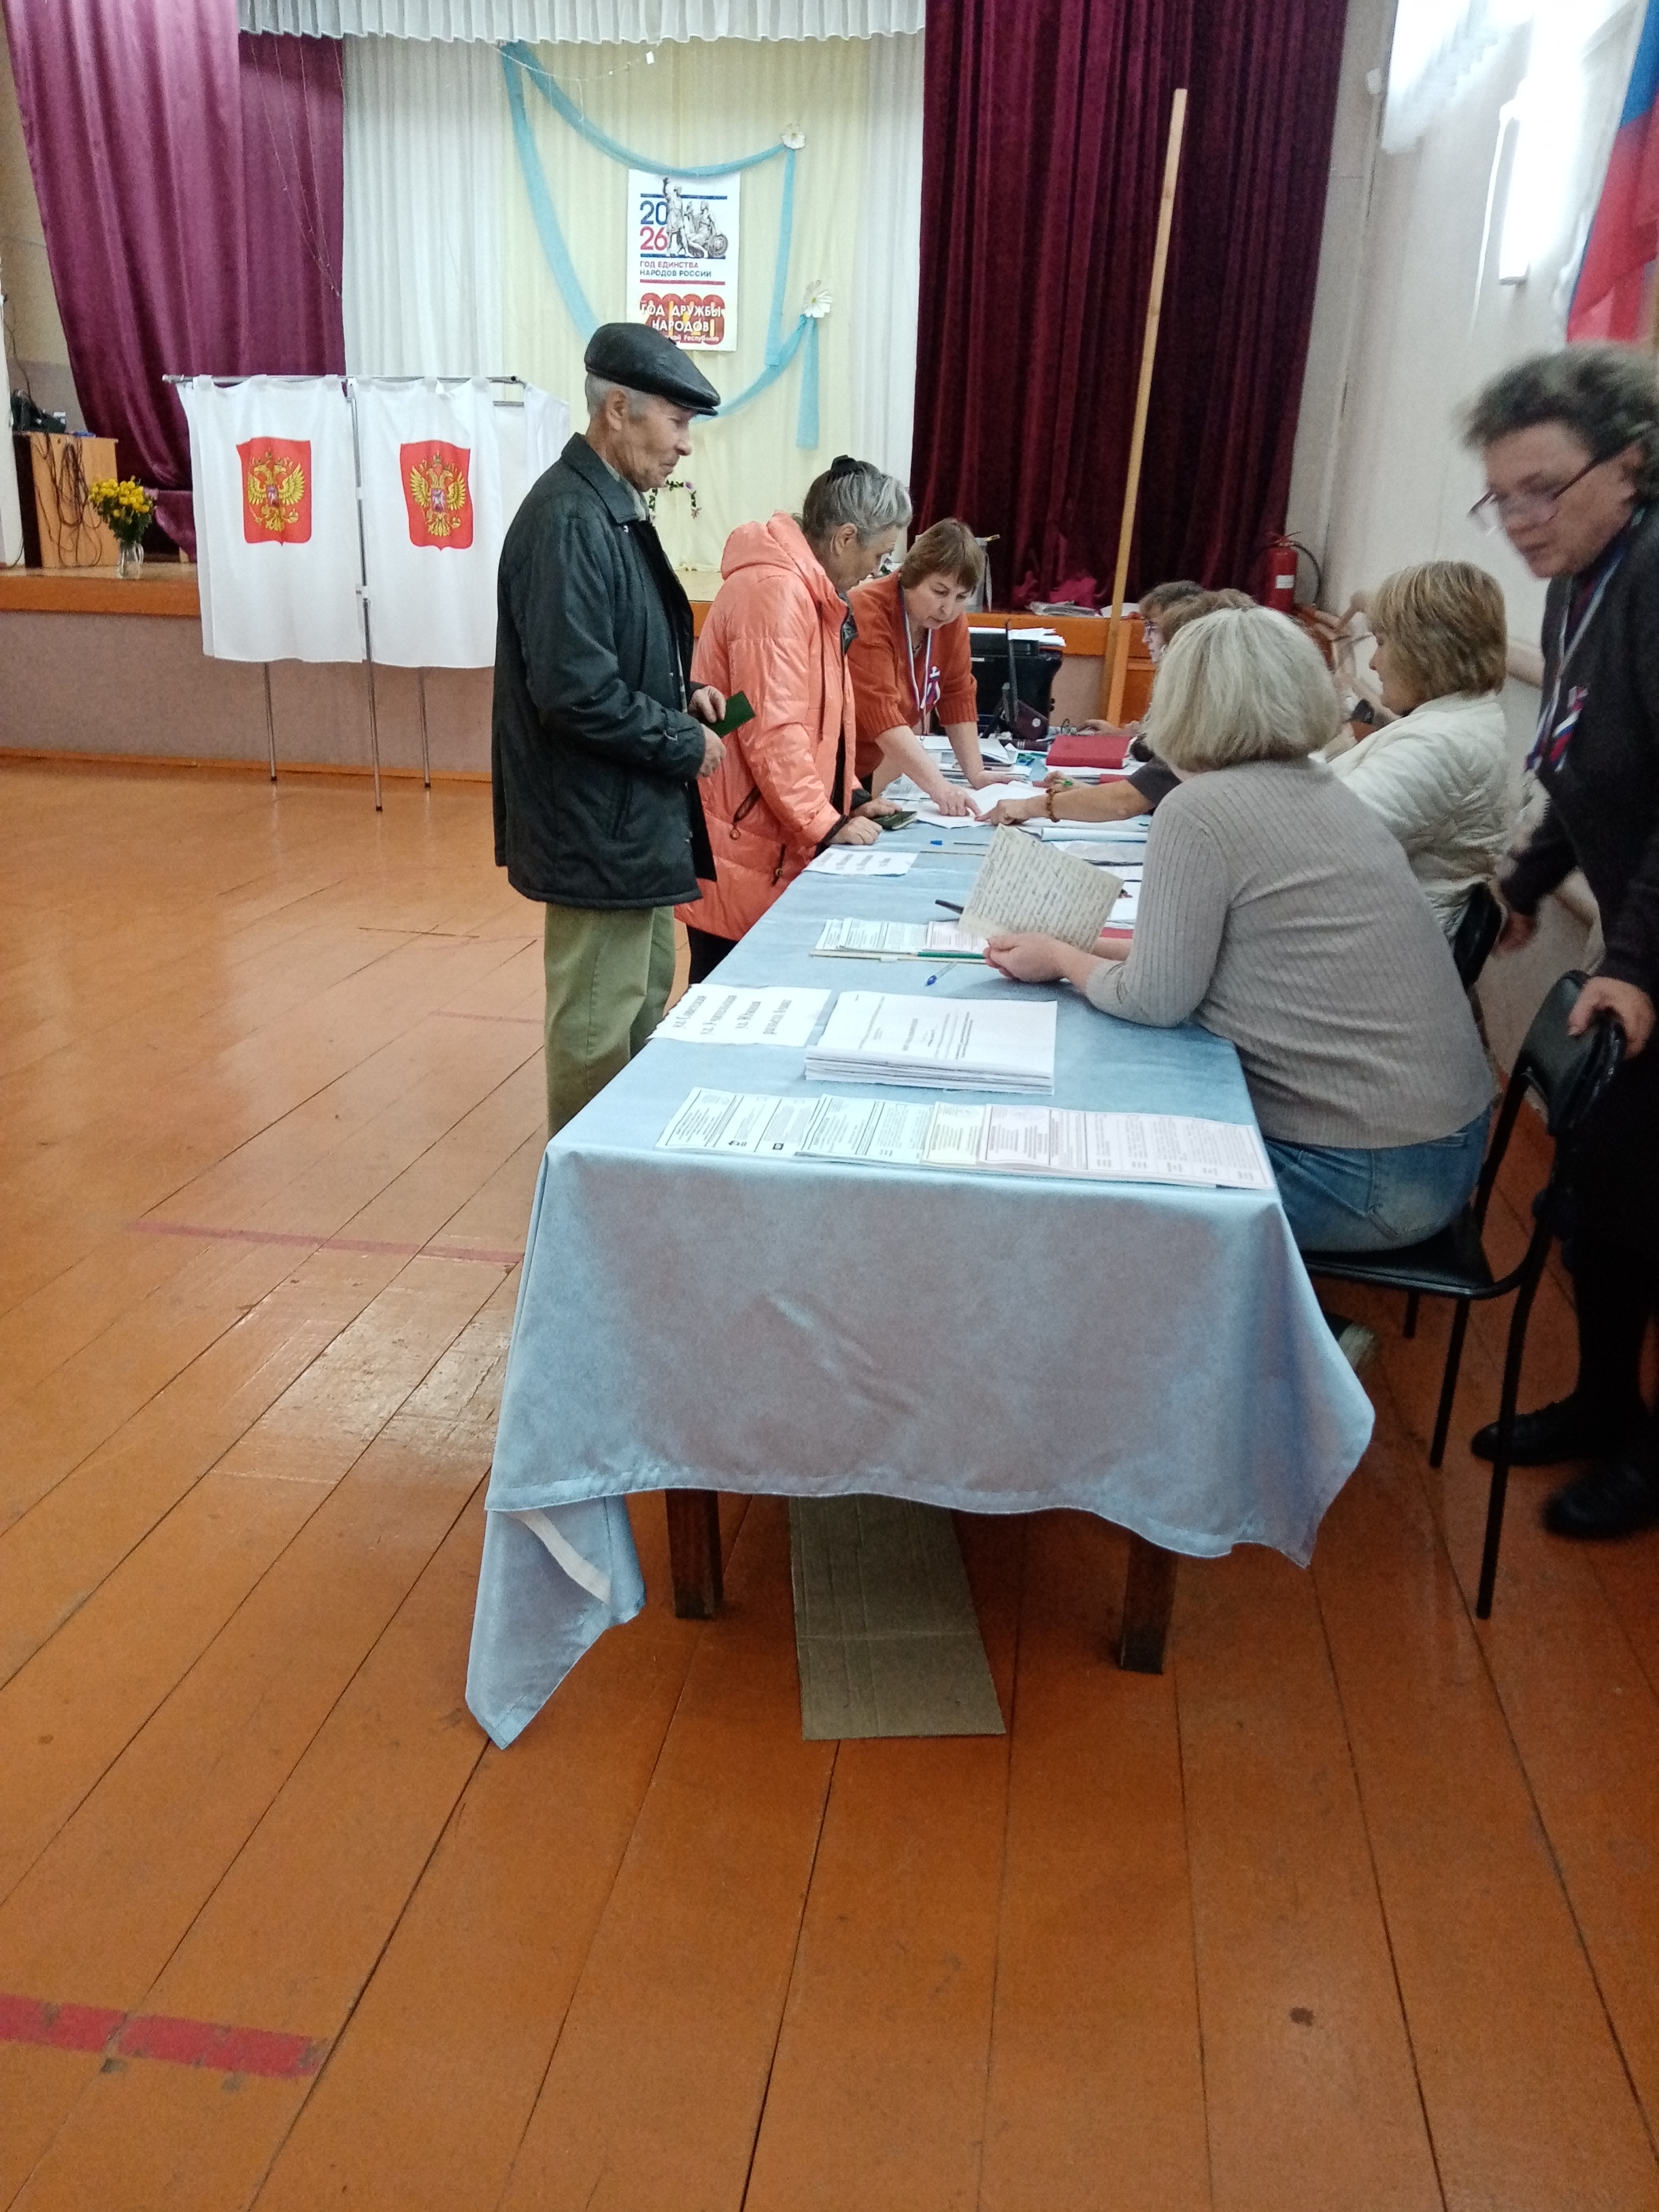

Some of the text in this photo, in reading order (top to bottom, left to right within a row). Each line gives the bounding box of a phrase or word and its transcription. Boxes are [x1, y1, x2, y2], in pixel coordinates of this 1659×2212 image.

[640, 200, 669, 225] 20
[640, 226, 668, 250] 26
[641, 304, 720, 317] ГОД ДРУЖБЫ
[652, 320, 709, 332] НАРОДОВ
